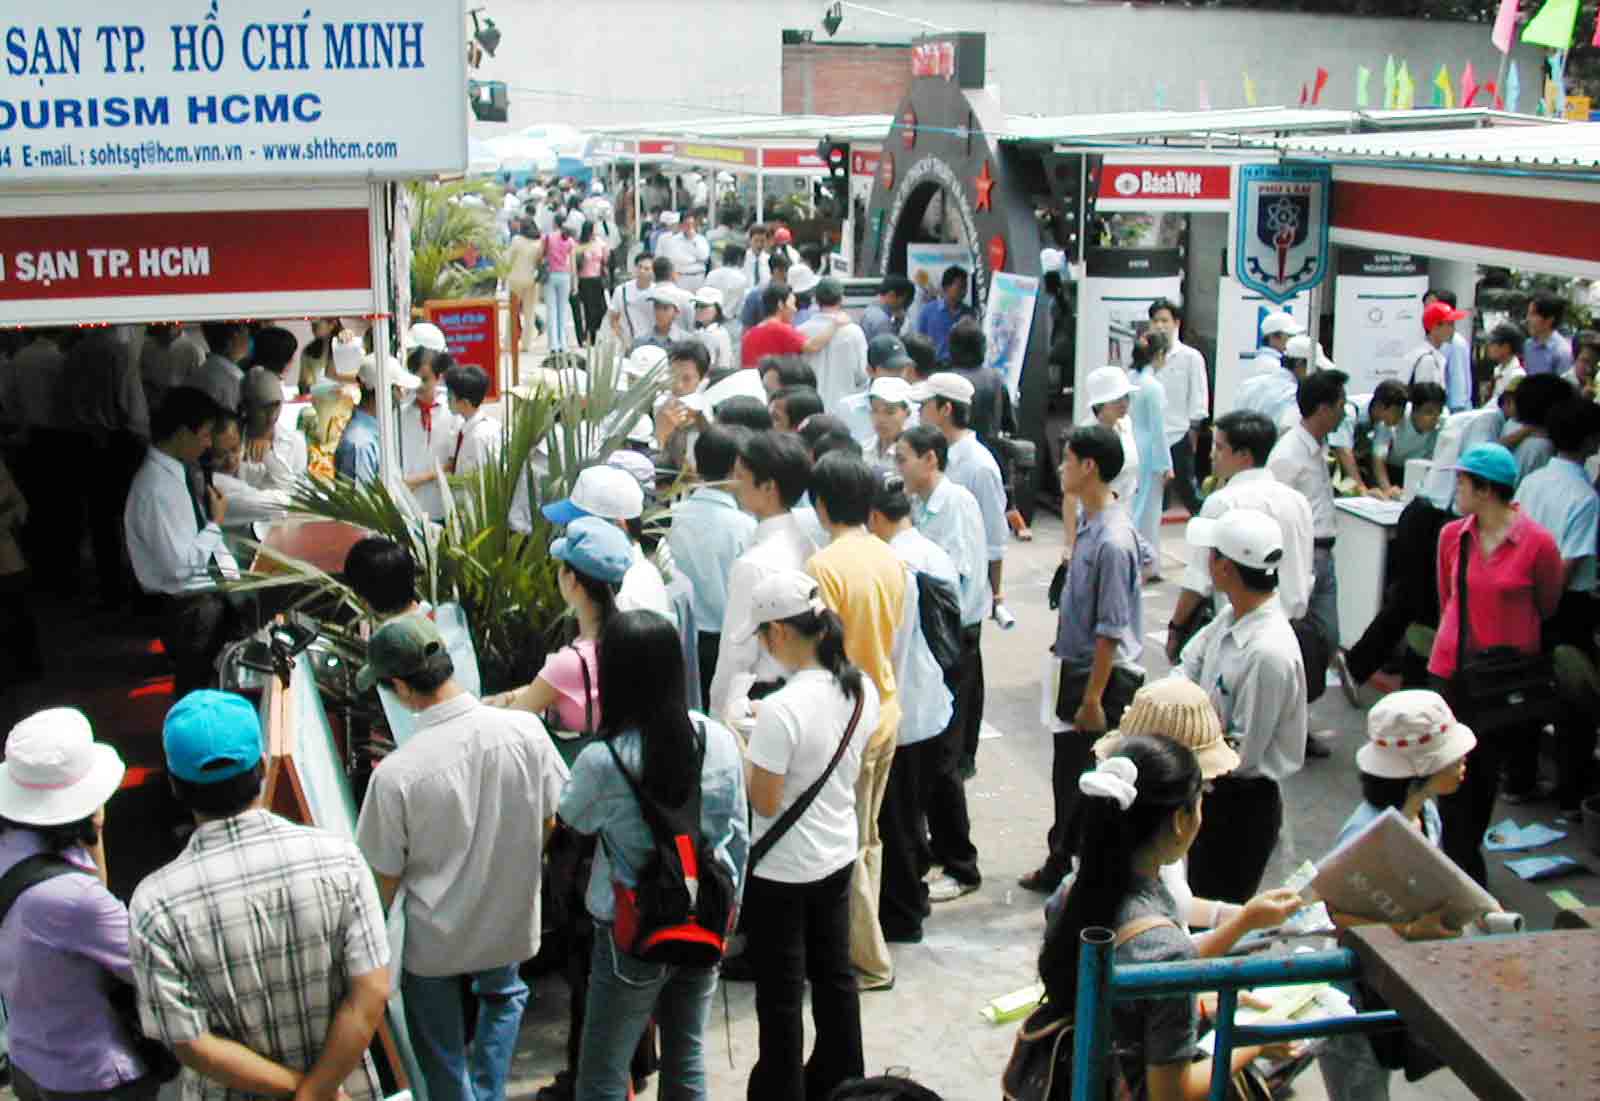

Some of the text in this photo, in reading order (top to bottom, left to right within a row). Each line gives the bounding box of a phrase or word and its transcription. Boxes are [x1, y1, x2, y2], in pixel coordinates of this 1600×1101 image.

[6, 0, 425, 88] SẠN TP. HỒ CHÍ MINH
[187, 92, 322, 125] HCMC
[262, 137, 399, 161] www.shthcm.com
[15, 250, 80, 286] SẠN
